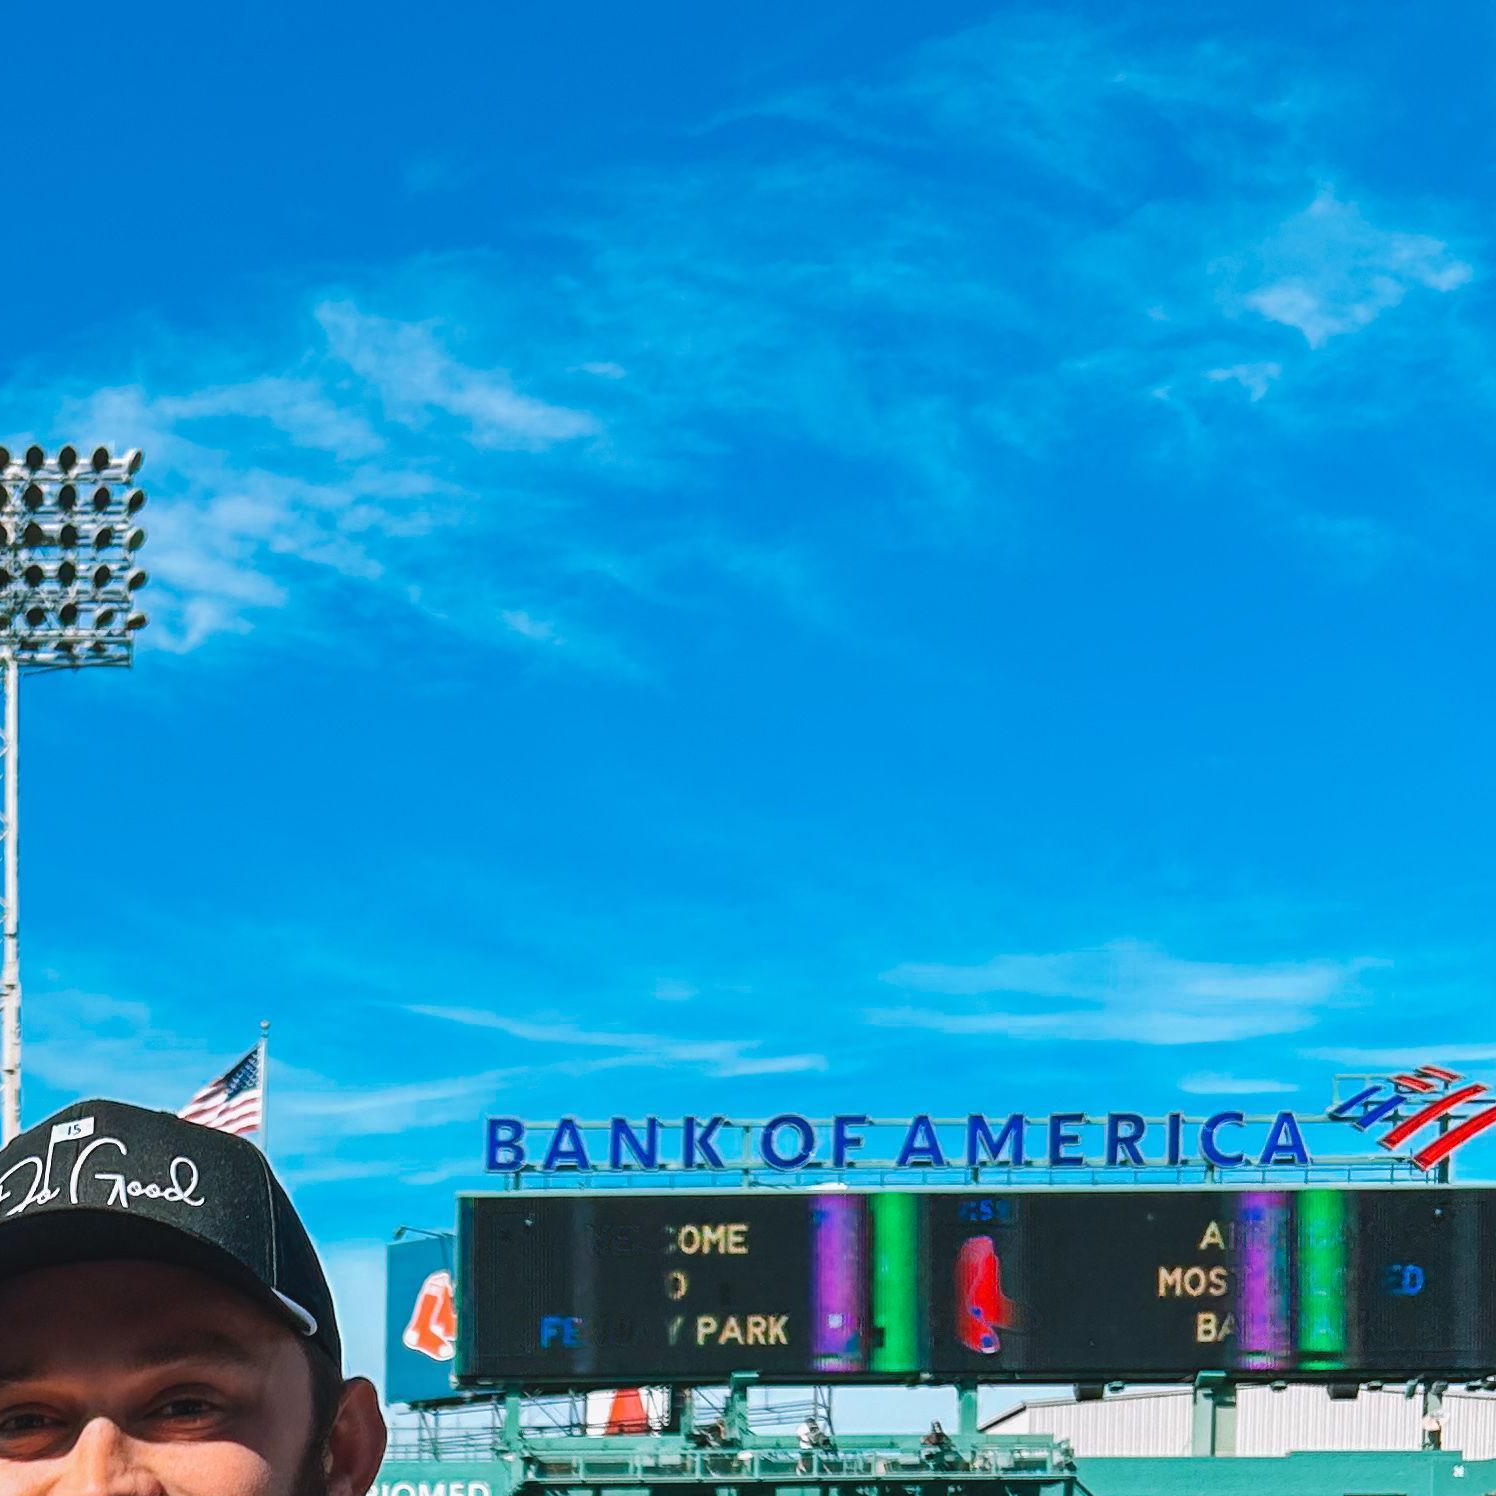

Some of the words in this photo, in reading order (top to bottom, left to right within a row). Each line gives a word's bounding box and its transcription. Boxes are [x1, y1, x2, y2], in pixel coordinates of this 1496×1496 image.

[66, 1123, 83, 1137] 15
[486, 1114, 730, 1172] BANK
[760, 1112, 870, 1171] OF
[896, 1111, 1314, 1169] AMERICA
[70, 1137, 206, 1209] Good
[1157, 1266, 1229, 1298] MOS
[696, 1314, 790, 1346] PARK
